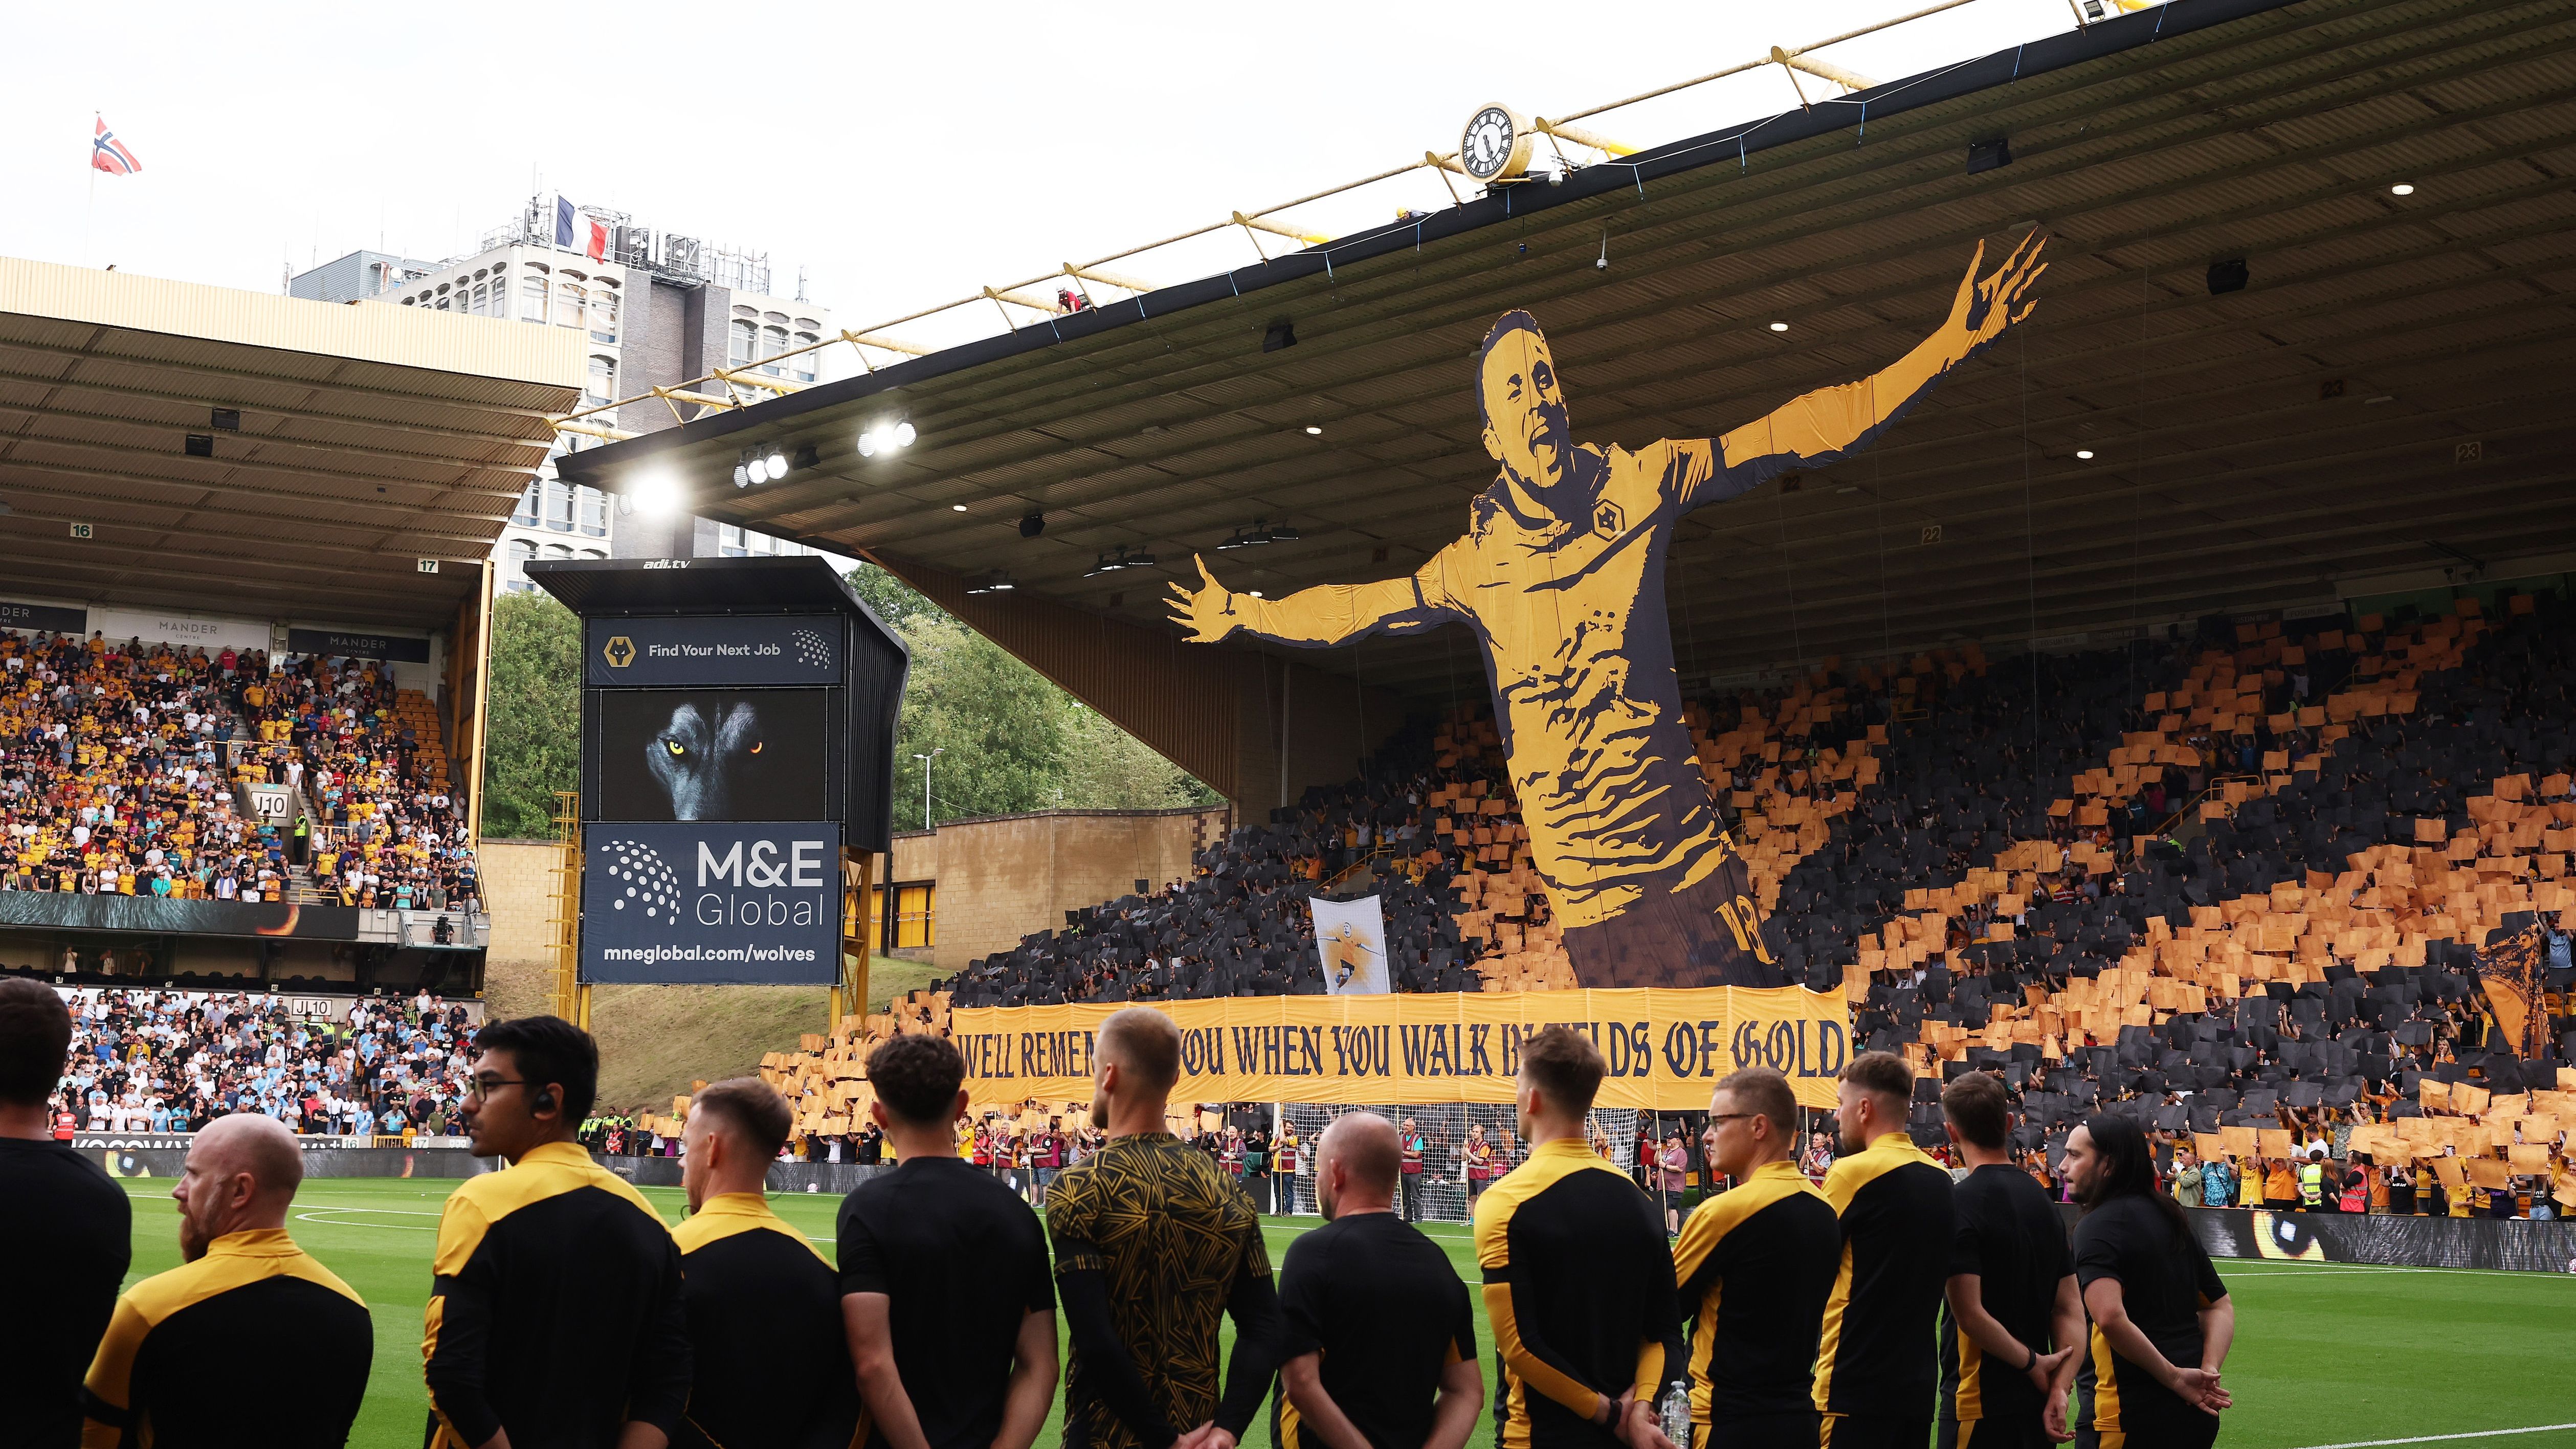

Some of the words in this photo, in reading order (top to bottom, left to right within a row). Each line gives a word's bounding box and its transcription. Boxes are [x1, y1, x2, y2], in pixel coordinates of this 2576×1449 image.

[2458, 443, 2479, 461] 23
[73, 525, 90, 537] 16
[1923, 527, 1940, 544] 22
[420, 560, 436, 571] 17
[643, 559, 691, 569] adi.tv
[159, 621, 217, 634] MANDER
[330, 636, 386, 649] MANDER
[649, 644, 678, 657] Find
[681, 644, 713, 656] Your
[717, 644, 750, 656] Next
[753, 643, 781, 655] Job
[257, 796, 284, 813] J10
[698, 840, 824, 887] M&E
[696, 893, 823, 925] Global
[604, 943, 815, 965] mneglobal.com/wolves
[297, 1001, 327, 1014] JL10
[1179, 1027, 1225, 1076] OU
[1231, 1026, 1323, 1076] WHEN
[1330, 1024, 1391, 1076] YOU
[1400, 1023, 1493, 1076] WALK
[1661, 1021, 1719, 1078] OF
[1730, 1019, 1844, 1077] GOLD
